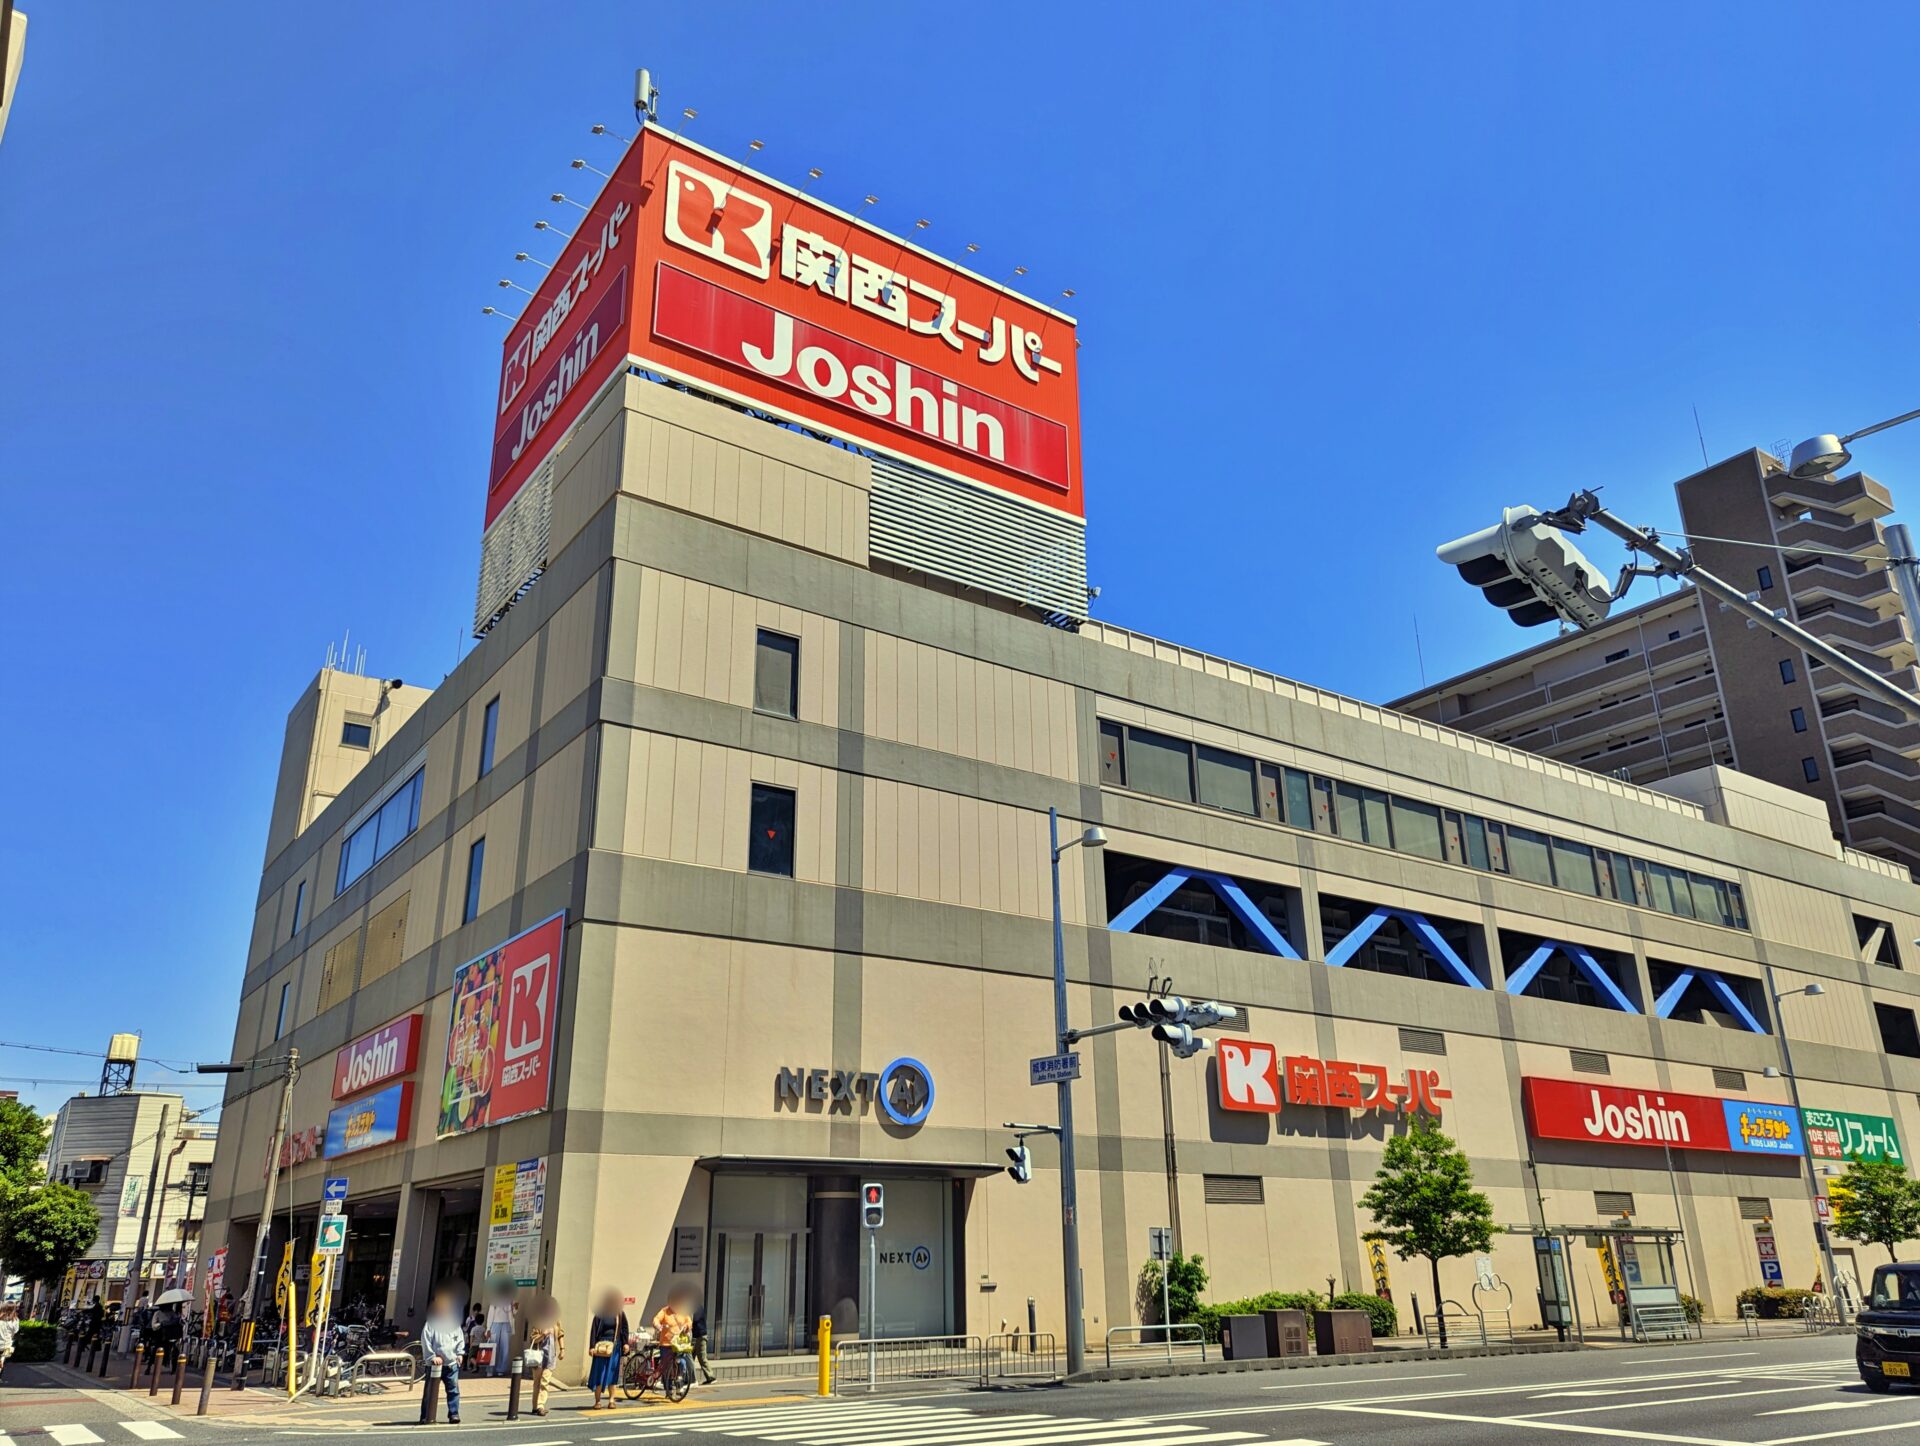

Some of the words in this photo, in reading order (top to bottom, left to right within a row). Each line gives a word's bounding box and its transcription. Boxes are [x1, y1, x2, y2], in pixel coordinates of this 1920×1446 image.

[531, 201, 632, 367] 関西スーパー
[780, 222, 1062, 382] 関西スーパー
[511, 322, 600, 461] Joshin
[741, 312, 1005, 462] Joshin
[342, 1028, 398, 1093] Joshin
[501, 1055, 541, 1087] 関西スーパー
[779, 1066, 880, 1102] NEXT
[1282, 1055, 1453, 1115] 関西スーパー
[1583, 1089, 1691, 1142] Joshin
[1805, 1110, 1834, 1127] まごころ
[1835, 1117, 1900, 1159] リフォーム
[879, 1252, 911, 1263] NEXT
[1763, 1262, 1778, 1279] P
